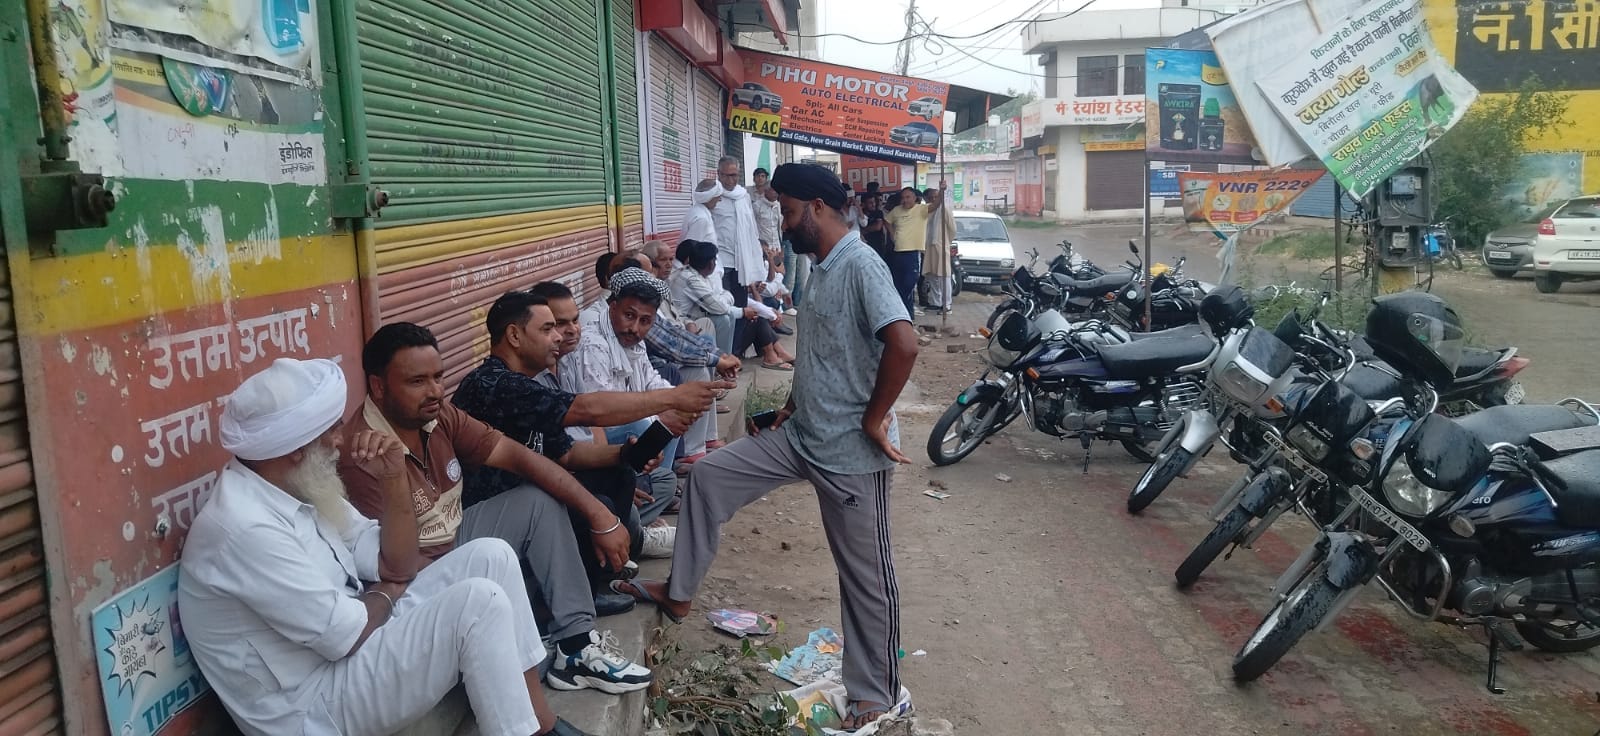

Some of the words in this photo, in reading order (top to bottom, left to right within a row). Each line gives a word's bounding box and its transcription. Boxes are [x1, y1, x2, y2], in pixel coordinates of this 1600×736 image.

[760, 62, 817, 86] PIHU
[825, 73, 909, 102] MOTOR
[1309, 68, 1322, 84] में
[801, 86, 832, 99] AUTO
[835, 92, 904, 111] ELECTRICAL
[792, 106, 808, 115] Car
[810, 109, 825, 117] AC
[828, 103, 840, 111] All
[842, 105, 863, 114] Cars
[732, 115, 758, 132] CAR
[762, 120, 778, 135] AC
[790, 114, 833, 126] Mechanical
[811, 136, 824, 145] New
[848, 166, 898, 190] PIHU
[1219, 181, 1259, 194] VNR
[236, 307, 310, 364] उत्पाद
[140, 401, 212, 468] उत्तम
[1358, 494, 1373, 509] HR
